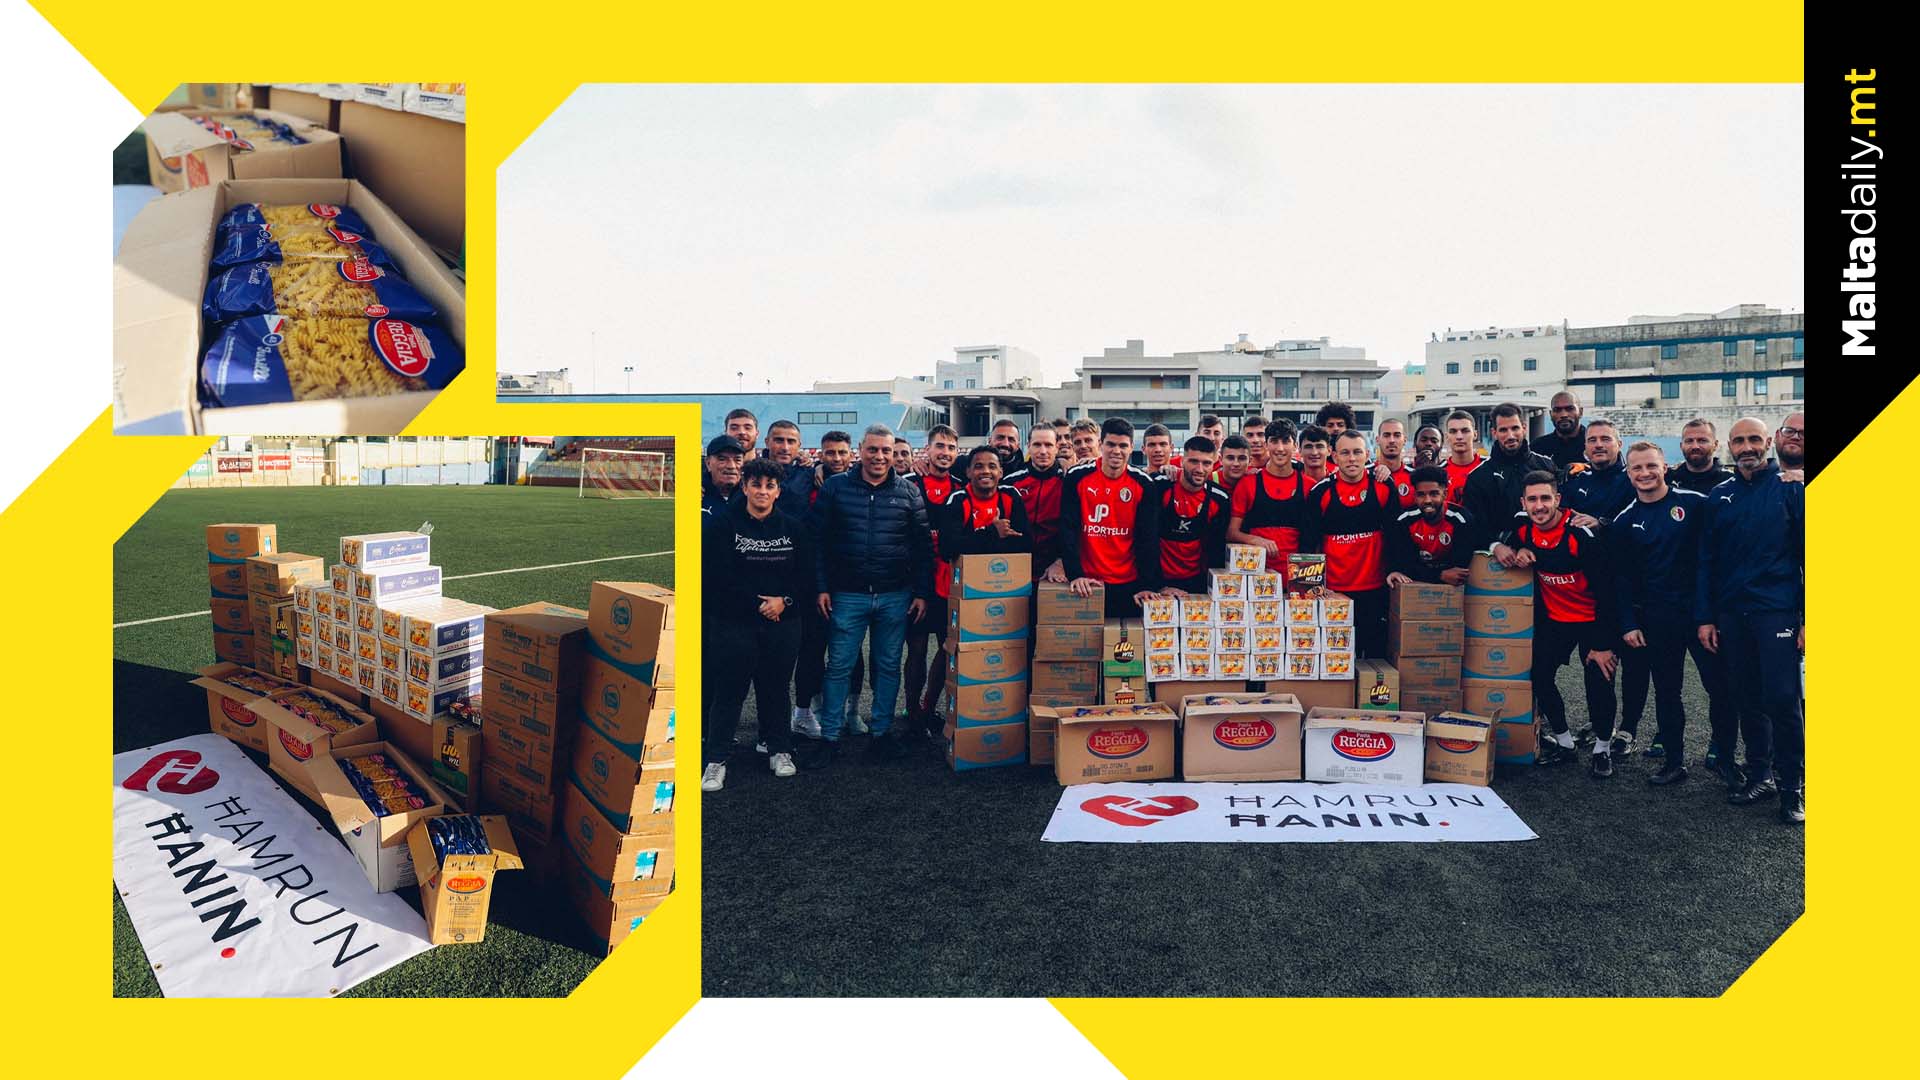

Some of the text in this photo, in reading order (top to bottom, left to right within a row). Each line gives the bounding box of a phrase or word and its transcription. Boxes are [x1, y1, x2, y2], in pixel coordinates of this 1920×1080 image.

[386, 321, 418, 367] REGGIA
[1088, 525, 1129, 536] PORTELLI
[1298, 563, 1325, 577] LION
[1221, 726, 1268, 738] REGGIA
[1094, 734, 1143, 746] REGGIA
[1339, 735, 1387, 749] REGGIA
